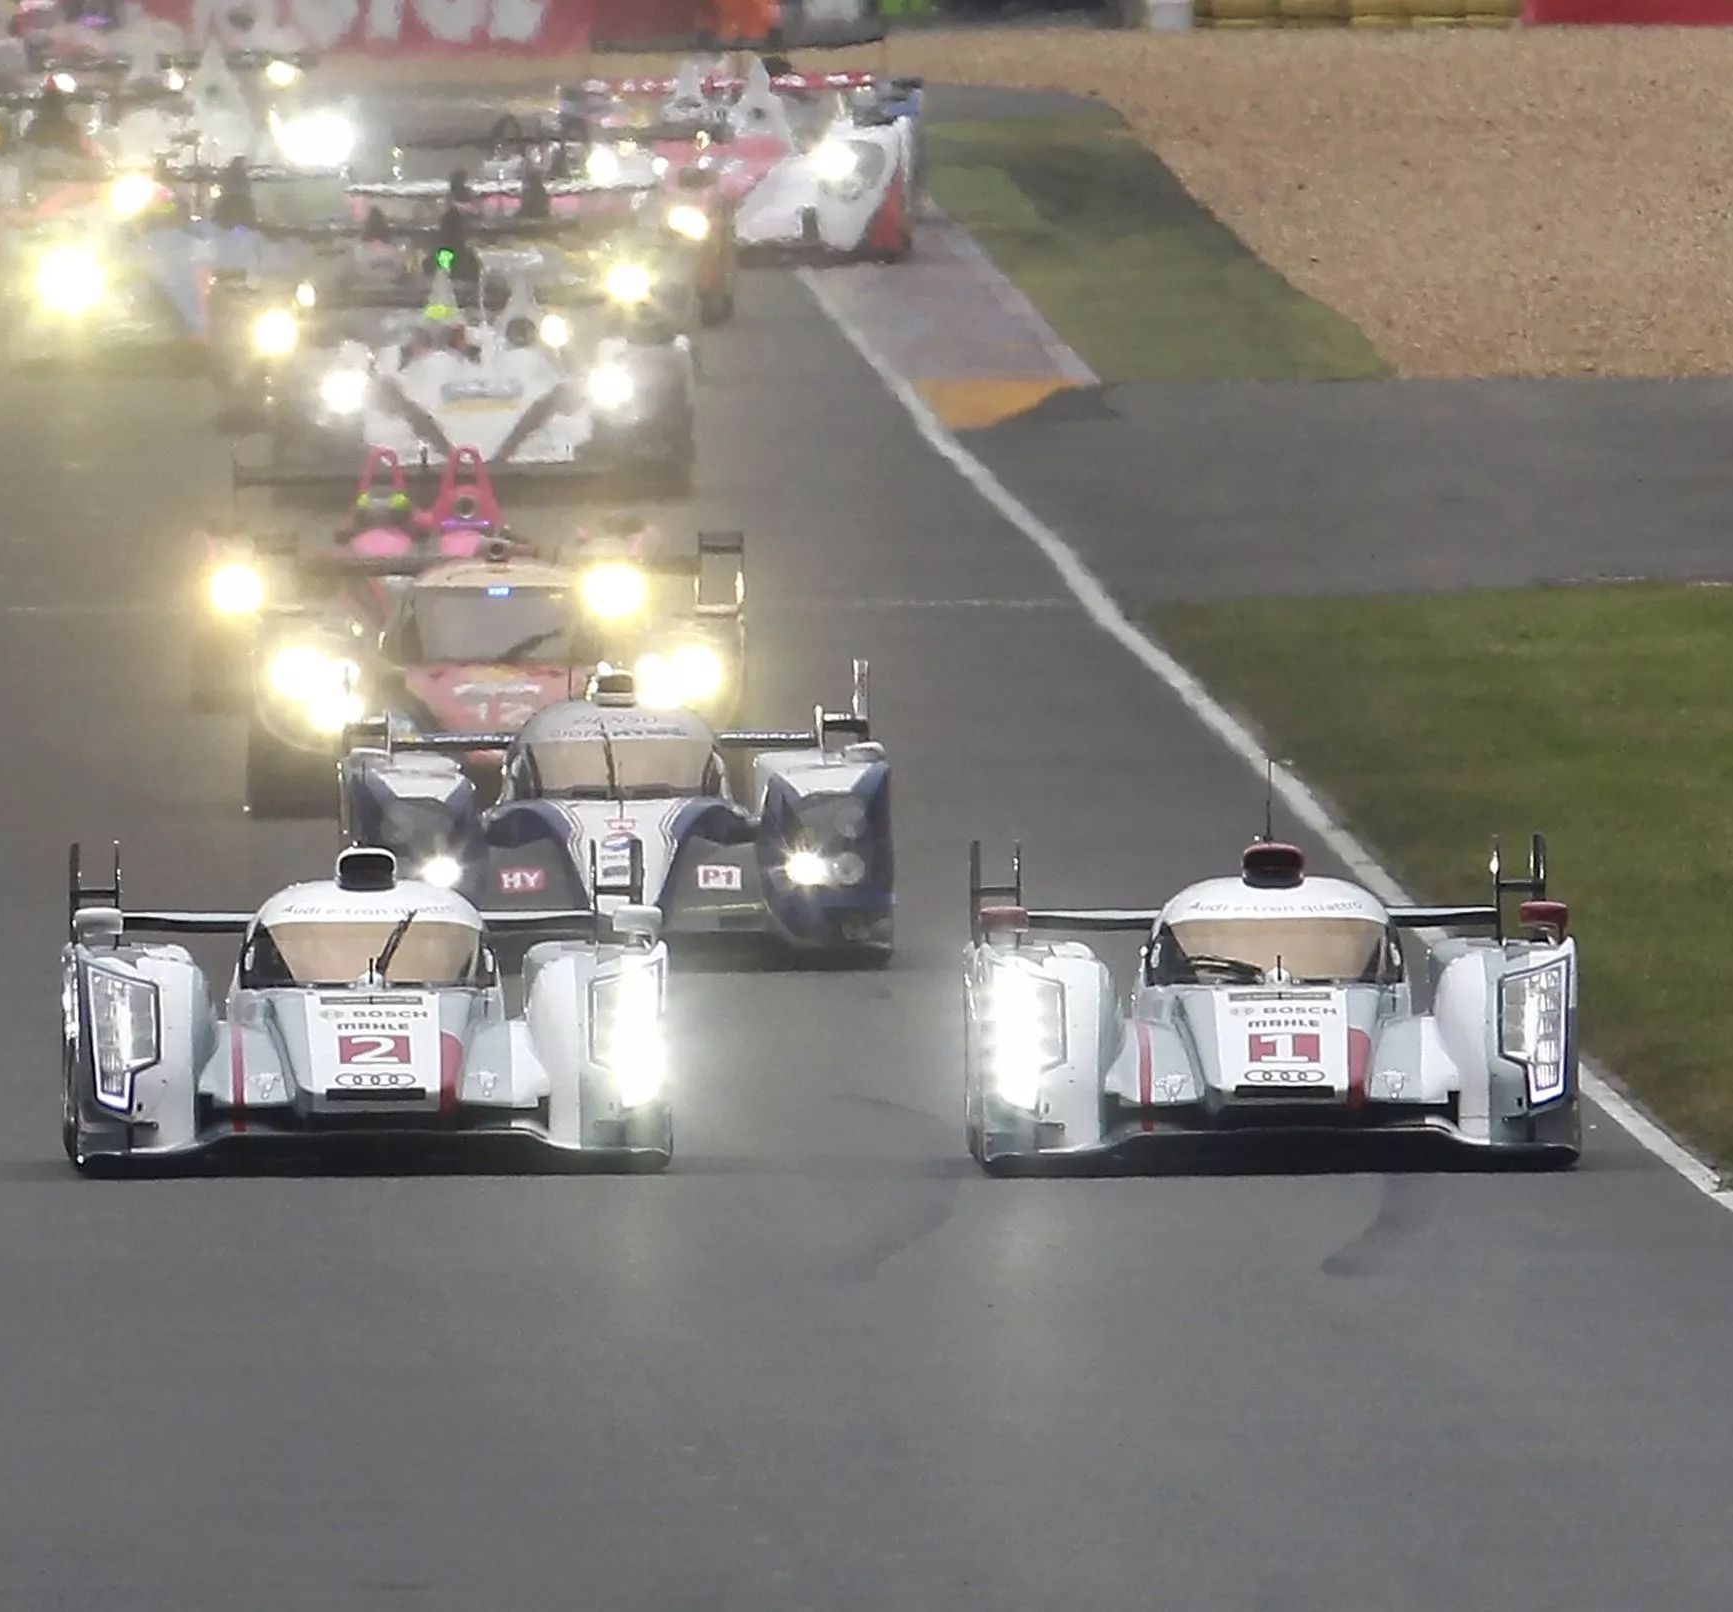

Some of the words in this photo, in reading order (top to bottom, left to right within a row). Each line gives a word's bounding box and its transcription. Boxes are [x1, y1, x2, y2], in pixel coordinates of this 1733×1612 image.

[500, 869, 543, 889] HY
[701, 868, 734, 885] P1
[280, 903, 321, 915] Audi
[1187, 901, 1229, 912] Audi
[352, 1009, 429, 1019] BOSCH
[1261, 1005, 1339, 1016] BOSCH
[349, 1035, 401, 1063] 2
[1258, 1034, 1310, 1063] 1
